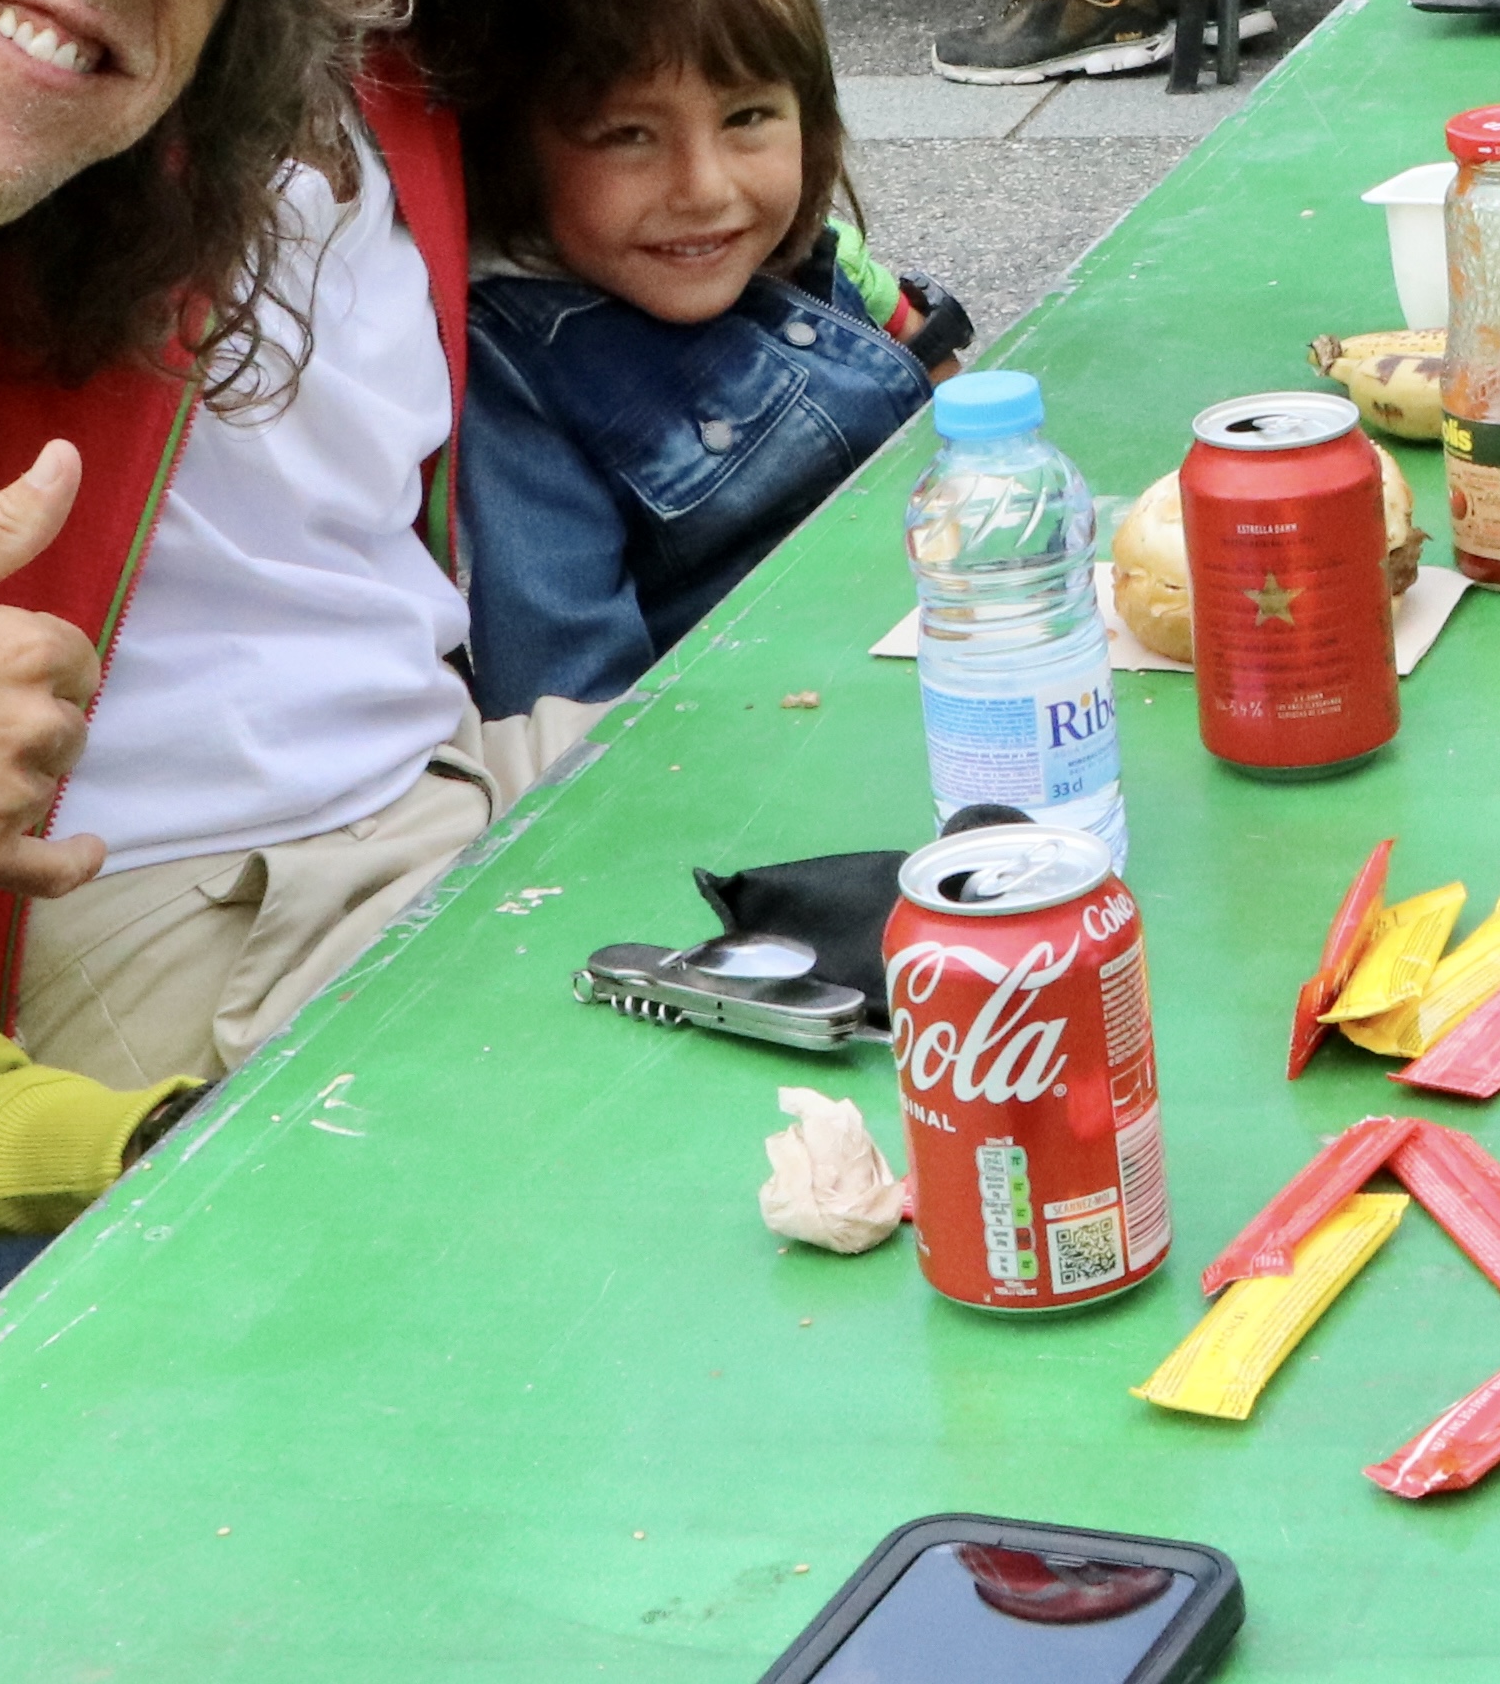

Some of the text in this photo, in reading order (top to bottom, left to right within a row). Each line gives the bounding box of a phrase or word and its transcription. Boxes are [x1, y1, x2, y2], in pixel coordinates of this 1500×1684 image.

[1237, 522, 1298, 535] ESTRELLA DAMM
[1052, 777, 1083, 799] 33 cl
[1082, 892, 1135, 942] Coke
[886, 940, 1080, 1104] Cola
[1052, 1191, 1112, 1216] SCANNEZ-MOI
